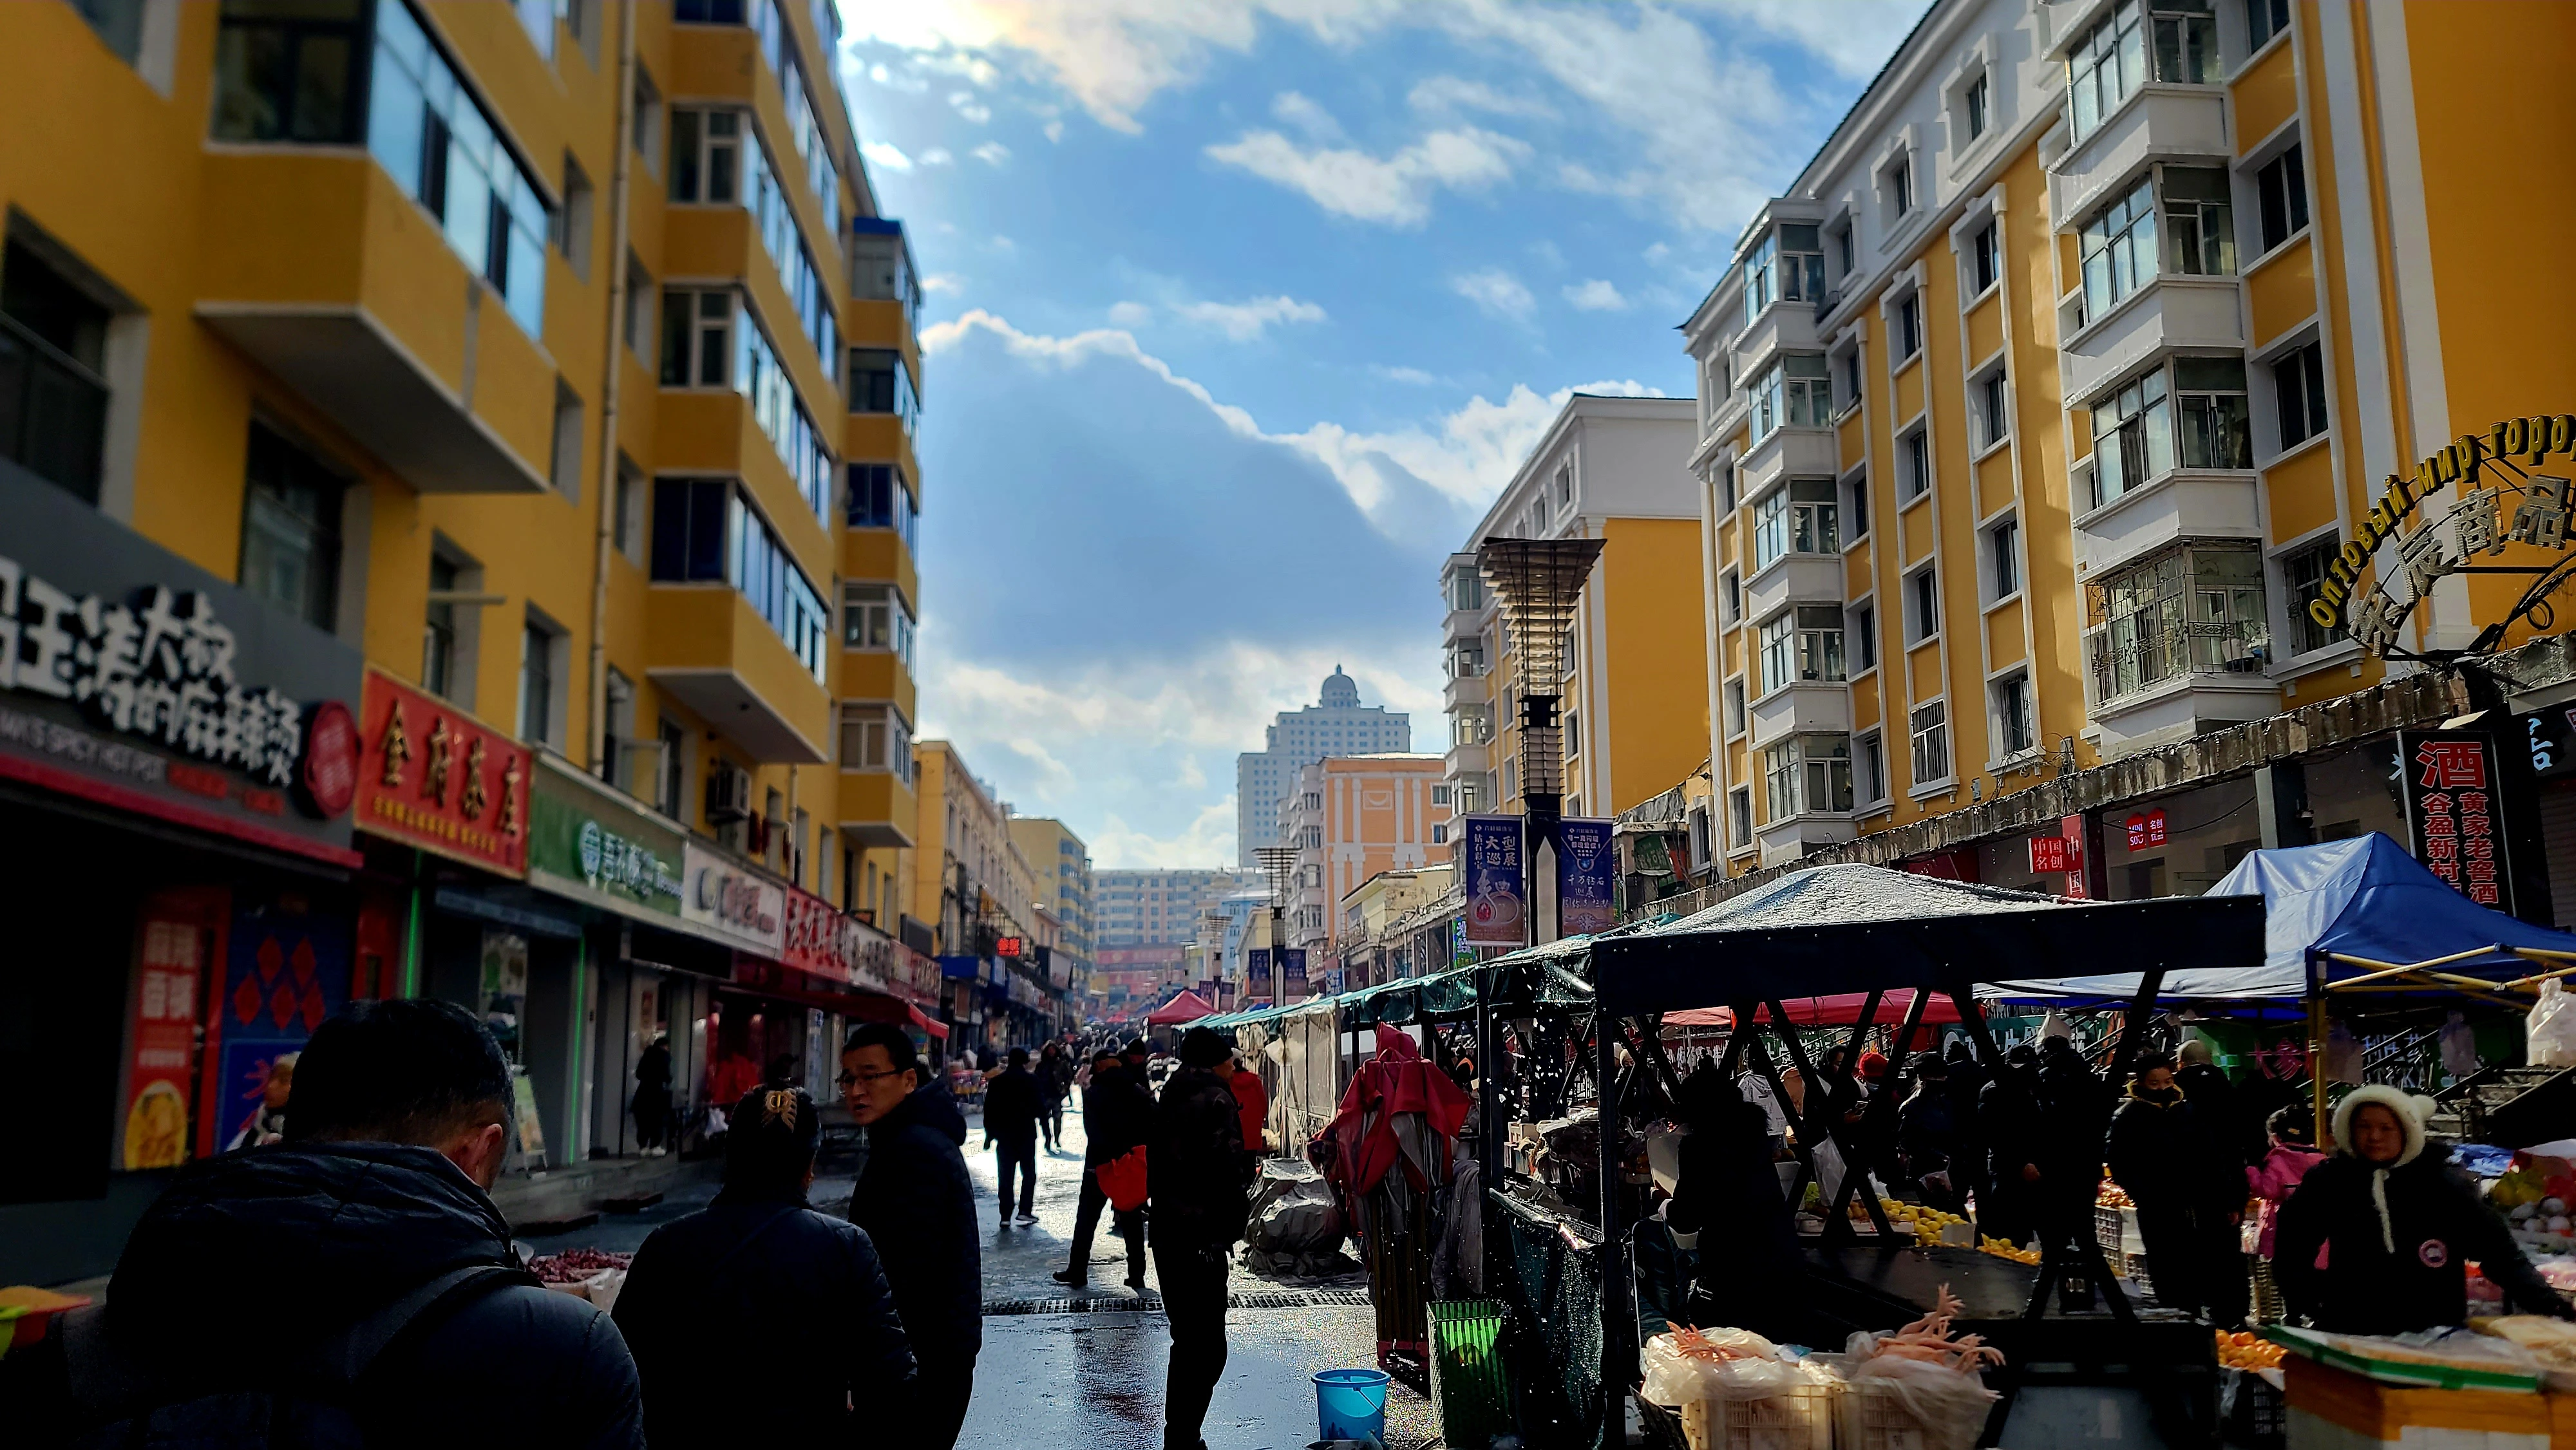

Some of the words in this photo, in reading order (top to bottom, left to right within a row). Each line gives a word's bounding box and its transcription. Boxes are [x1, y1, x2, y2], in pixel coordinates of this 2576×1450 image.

[2309, 475, 2410, 629] Оптовый
[2416, 435, 2479, 496] мир
[2416, 740, 2486, 789] 酒
[2128, 823, 2143, 834] MINI
[2150, 818, 2163, 830] 名创
[1484, 835, 1516, 851] 大型
[2034, 838, 2062, 855] 中国
[2420, 792, 2462, 894] 谷盈新村
[2458, 791, 2499, 905] 黄家老窖酒
[1486, 852, 1518, 867] 巡展
[2035, 854, 2063, 870] 名创
[1567, 874, 1605, 886] 千万钻石
[1575, 886, 1595, 898] 巡展
